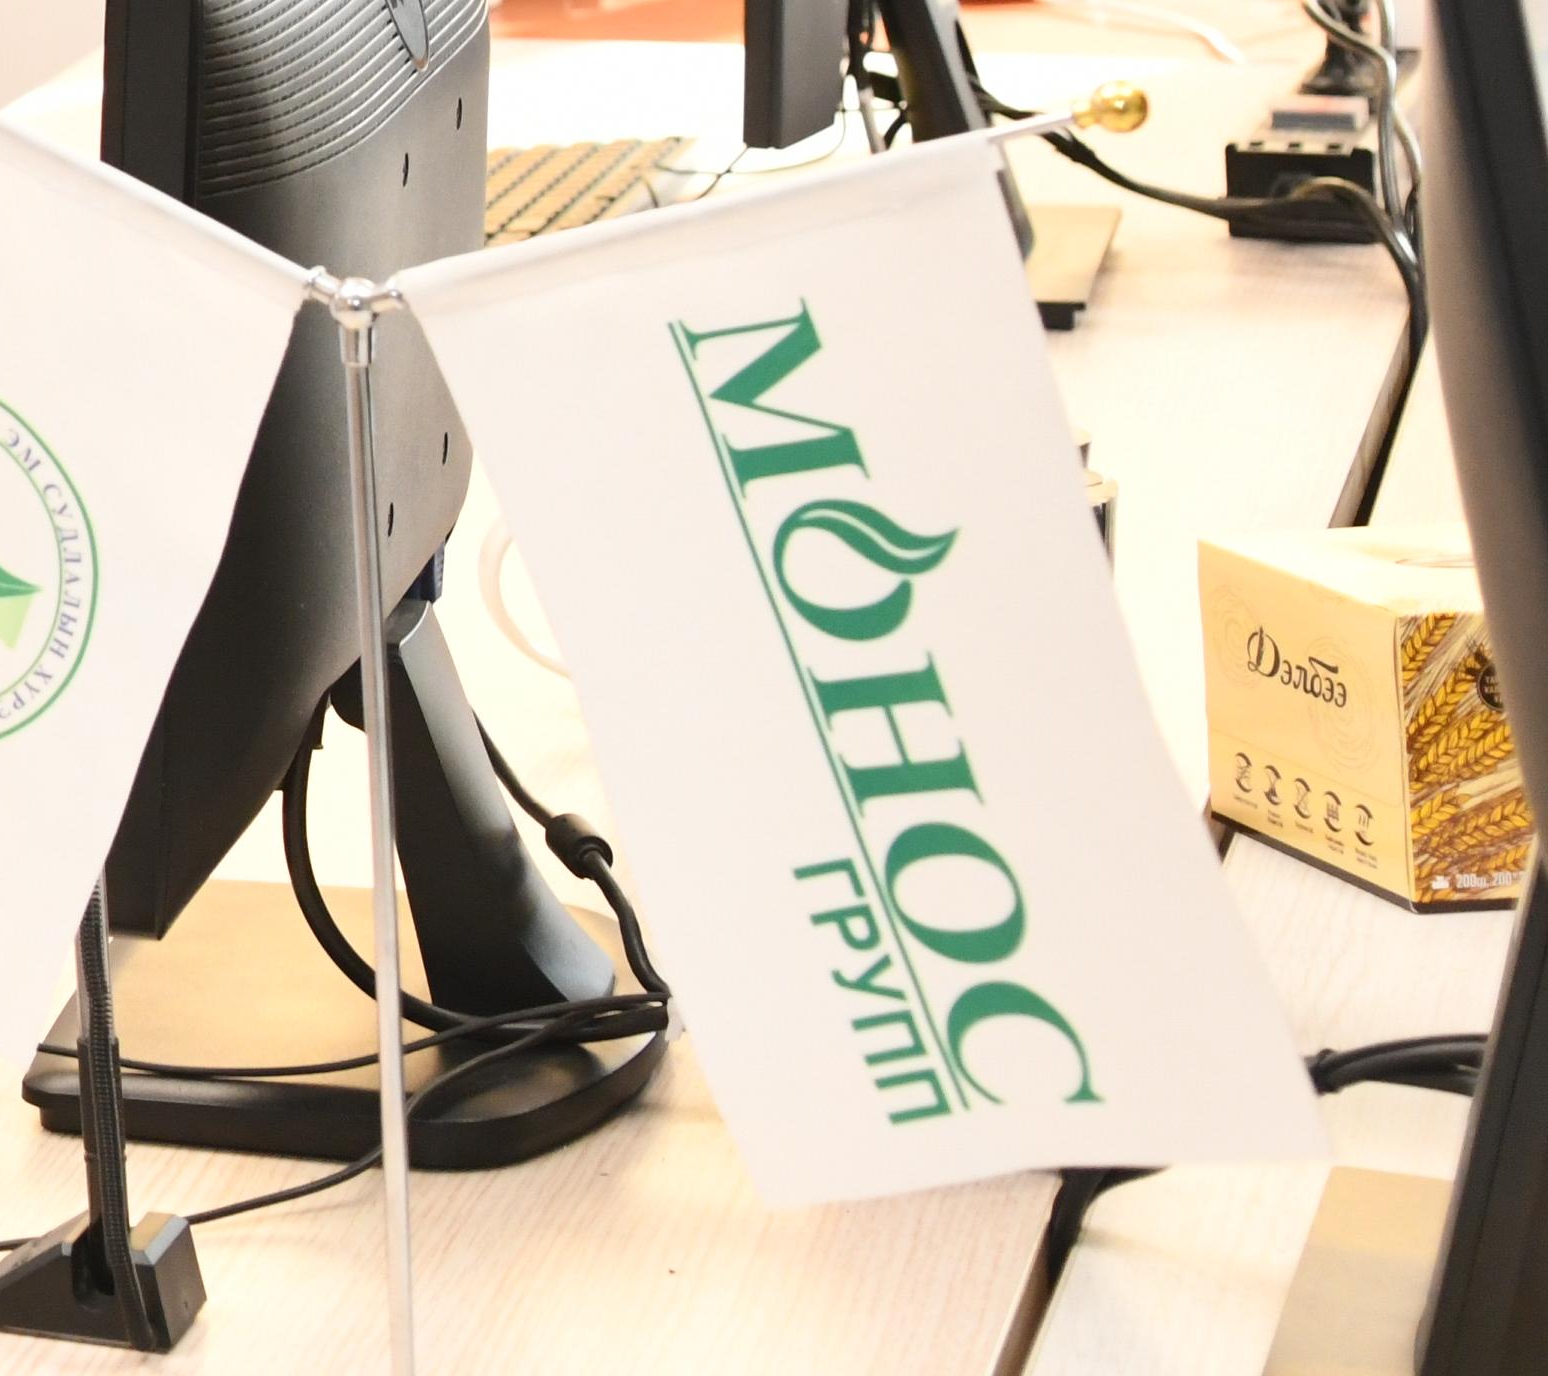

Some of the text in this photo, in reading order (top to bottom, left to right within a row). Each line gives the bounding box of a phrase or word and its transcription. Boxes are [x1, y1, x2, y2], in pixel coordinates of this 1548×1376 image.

[42, 481, 84, 660] СУДЛАЛЫН
[1245, 624, 1349, 709] Дэлбээ
[677, 294, 1106, 1110] МОНОС
[790, 853, 955, 1129] ГРУПП
